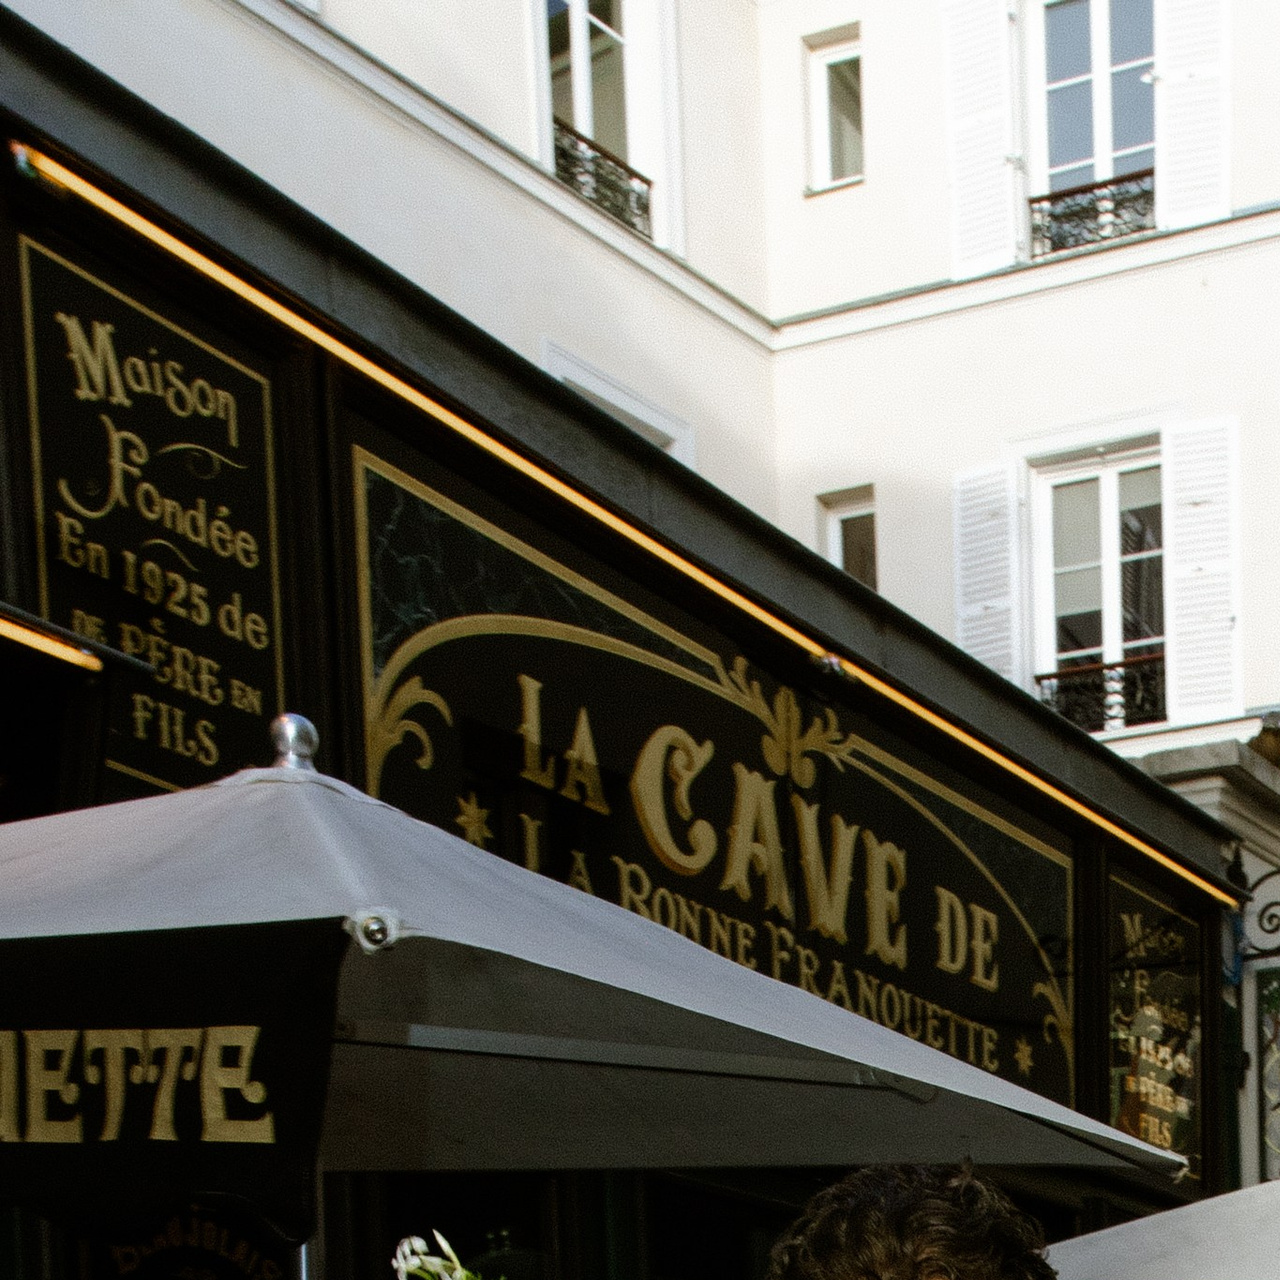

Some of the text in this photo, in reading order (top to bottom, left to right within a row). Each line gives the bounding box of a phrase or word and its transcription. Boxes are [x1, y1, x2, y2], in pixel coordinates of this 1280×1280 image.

[54, 311, 239, 448] Maison
[57, 413, 259, 569] Fondée
[55, 511, 271, 651] En 1925 de
[118, 617, 225, 707] PÈRE
[229, 678, 264, 716] EN
[131, 693, 220, 767] FILS
[517, 673, 999, 992] LA CAVE DE
